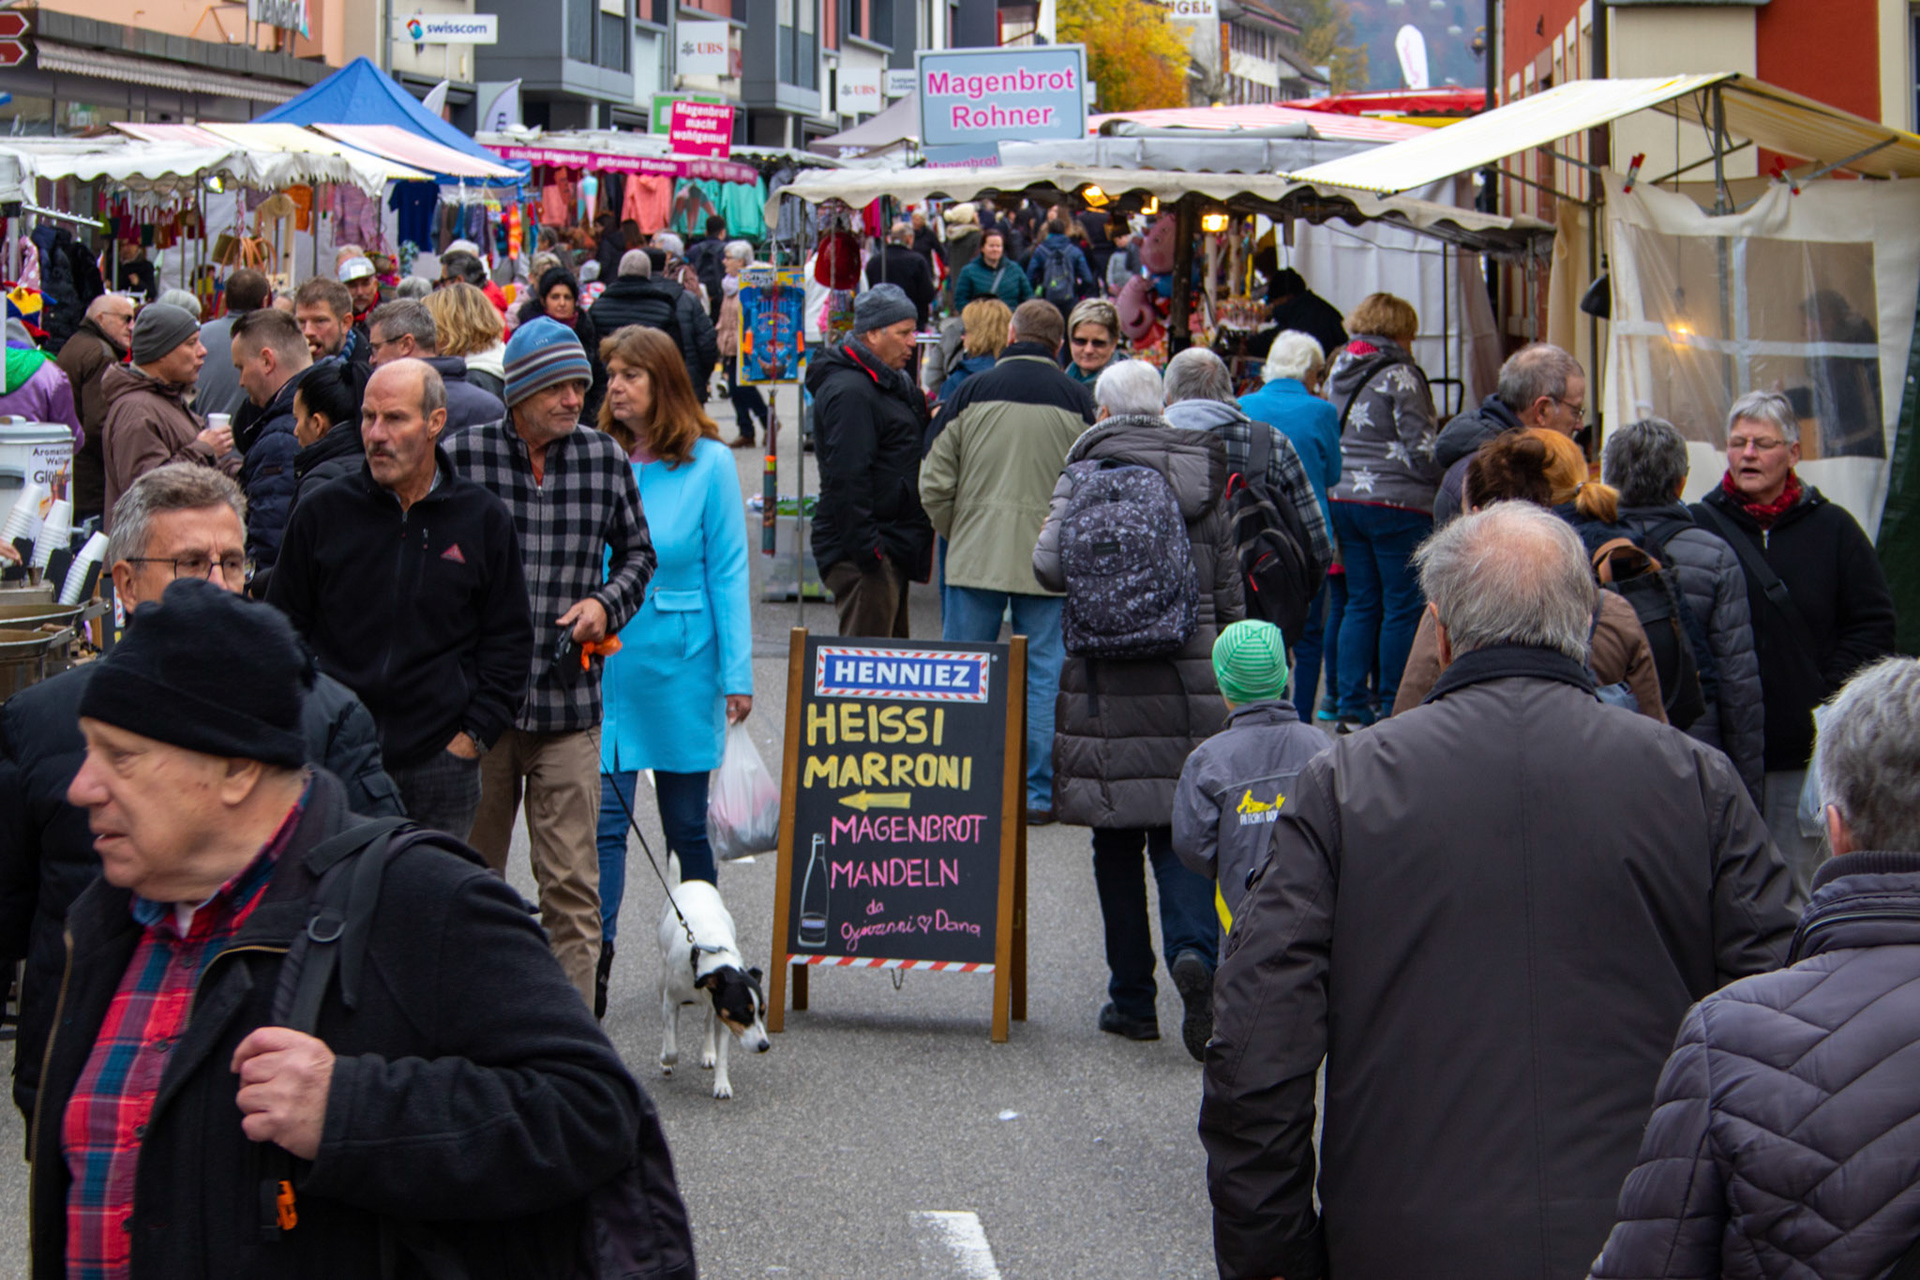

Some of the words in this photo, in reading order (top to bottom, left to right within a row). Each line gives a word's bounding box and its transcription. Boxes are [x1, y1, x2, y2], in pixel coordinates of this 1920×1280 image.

[426, 21, 487, 34] swisscom
[697, 42, 724, 55] UBS
[853, 85, 876, 95] UBS
[928, 68, 1075, 99] Magenbrot
[675, 102, 730, 118] Magenbrot
[952, 105, 1053, 128] Rohner
[685, 118, 717, 130] macht
[672, 130, 728, 144] wohlgemut
[543, 151, 588, 164] Magenbrot
[641, 160, 677, 172] Mandeln
[834, 660, 970, 688] HENNIEZ
[807, 703, 944, 746] HEISSI
[803, 752, 972, 790] MARRONI
[831, 815, 988, 846] MAGENBROT
[831, 858, 959, 889] MANDELN
[865, 899, 885, 916] da
[935, 908, 981, 938] Dana
